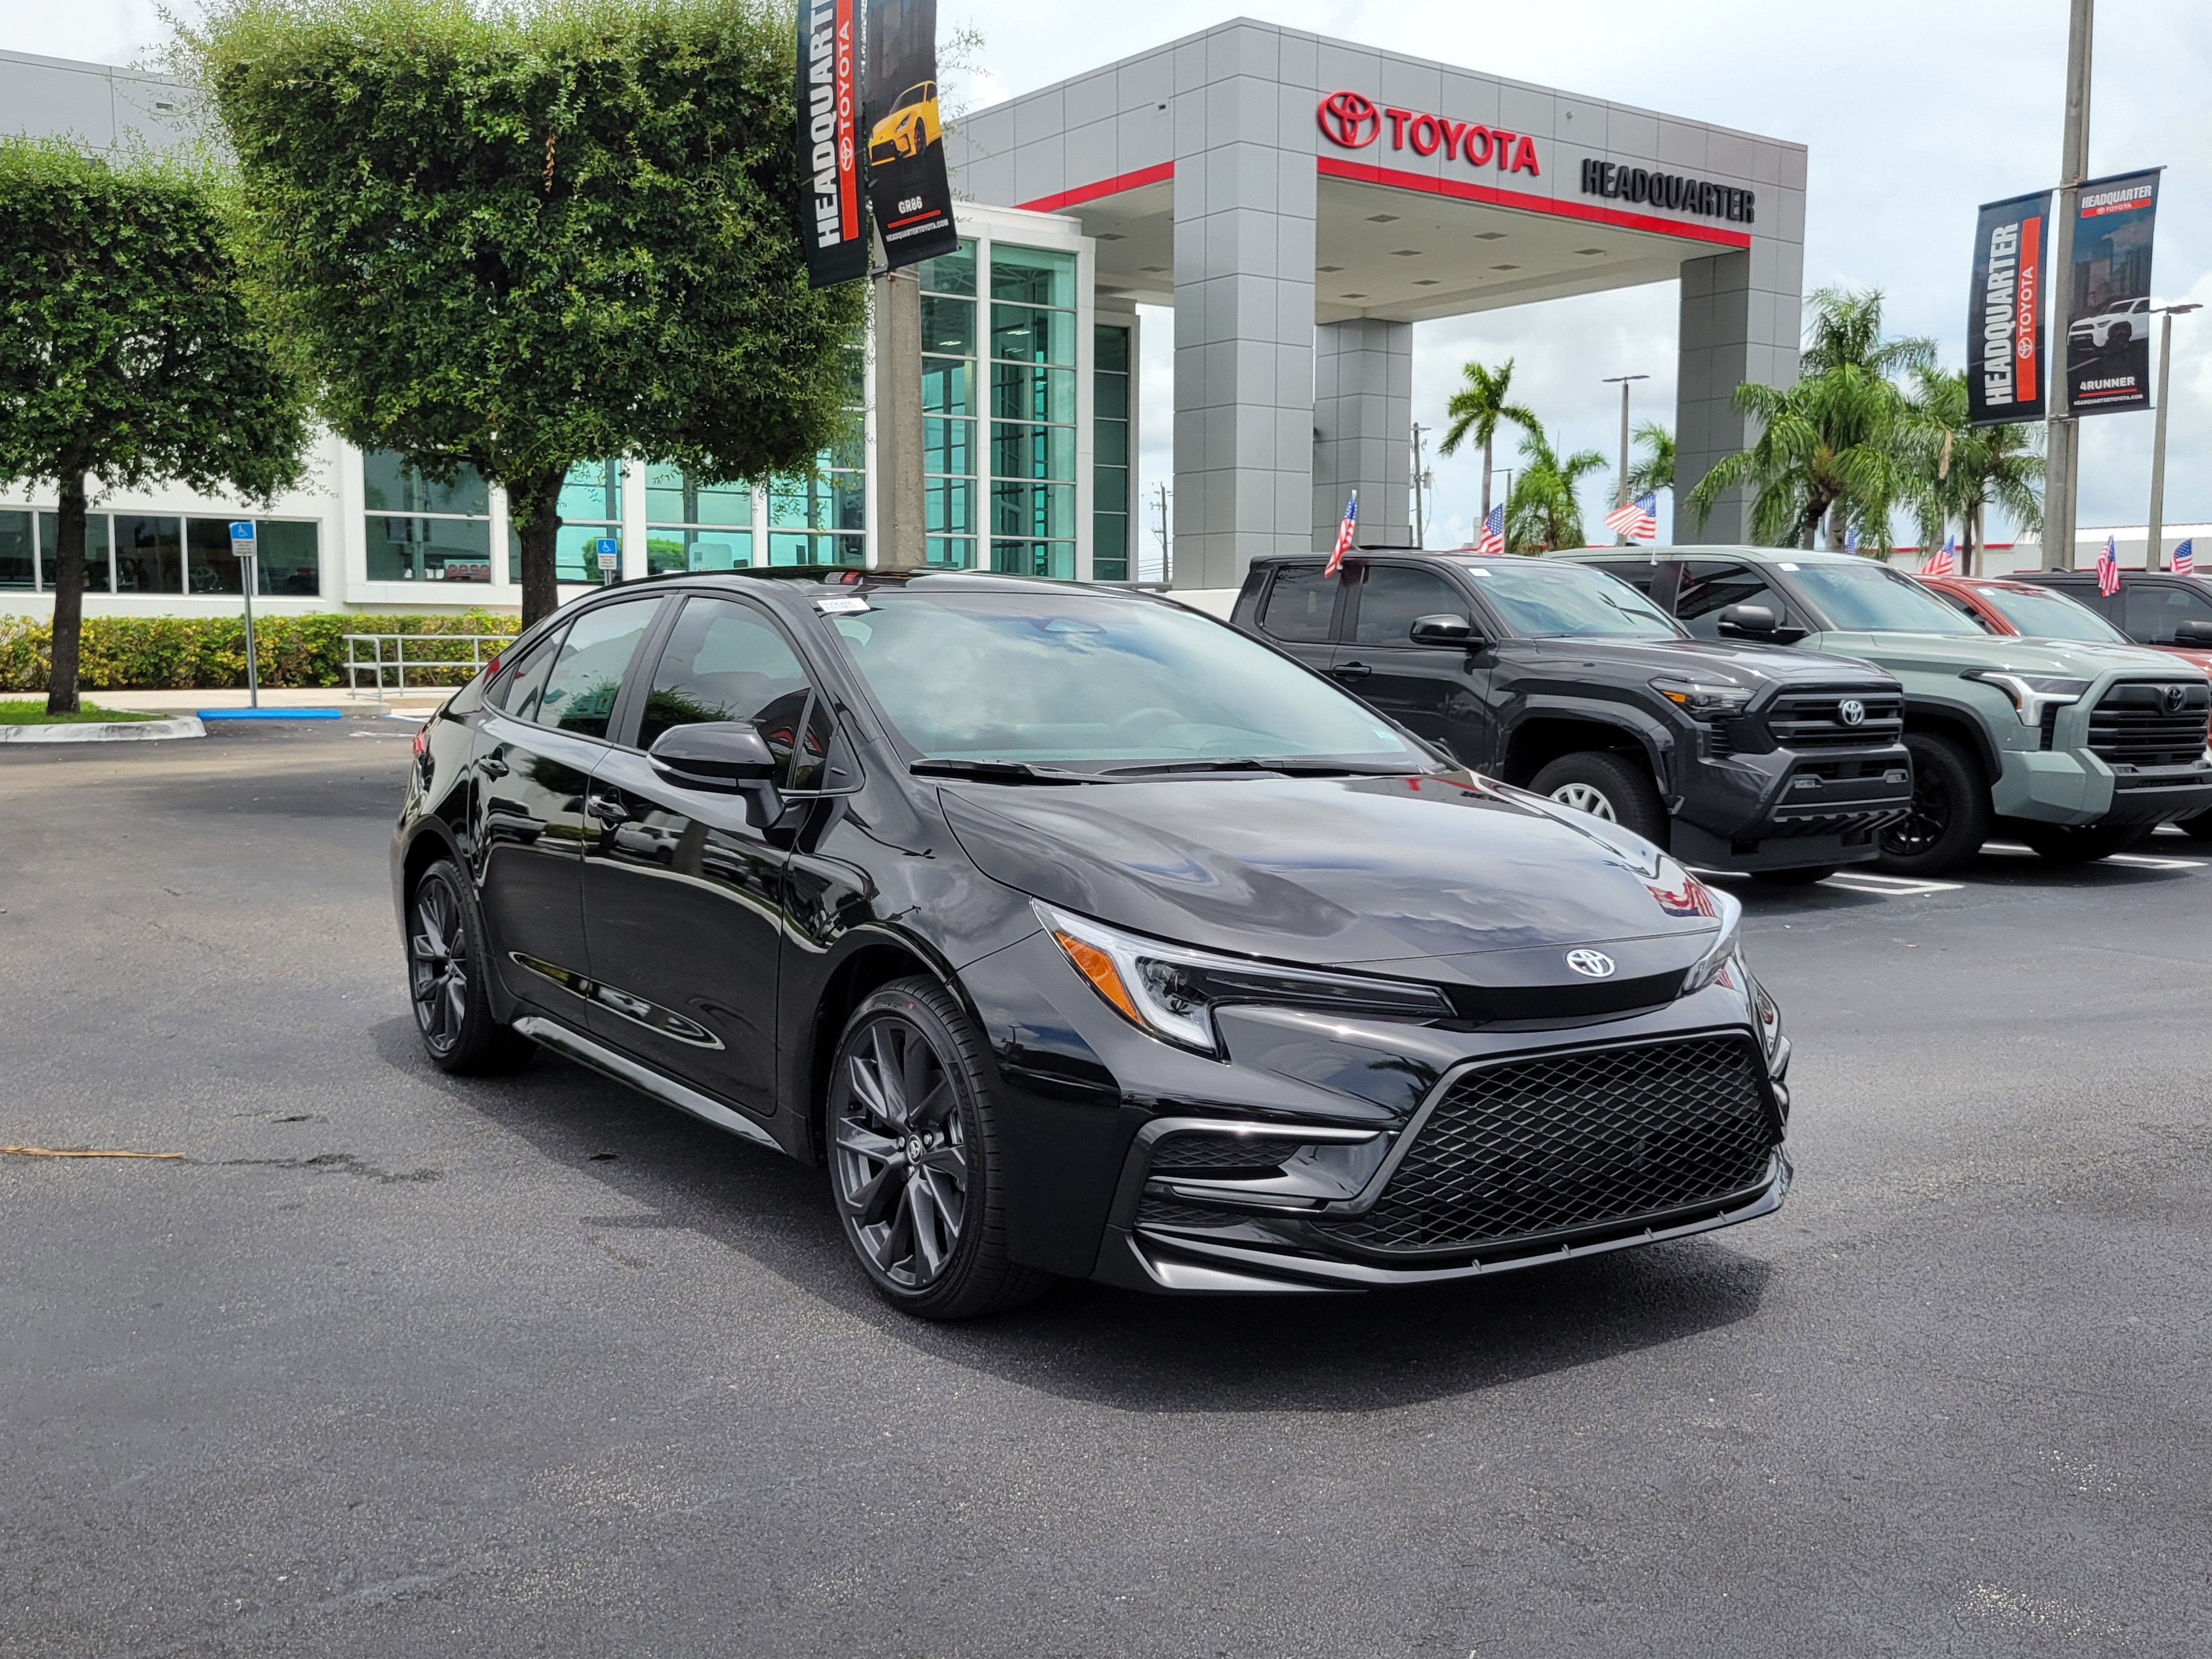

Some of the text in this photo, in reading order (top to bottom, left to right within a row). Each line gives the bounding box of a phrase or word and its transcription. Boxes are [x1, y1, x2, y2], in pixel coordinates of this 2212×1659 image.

[839, 21, 850, 134] TOYOTA
[1385, 108, 1540, 176] TOYOTA
[898, 196, 923, 215] GR86
[1583, 158, 1755, 223] HEADQUARTER
[2081, 185, 2152, 208] HEADQUARTER
[2107, 202, 2132, 212] TOYOTA
[1984, 222, 2019, 407] HEADQUARTER
[2019, 266, 2034, 336] TOYOTA
[2080, 376, 2135, 391] 4RUNNER
